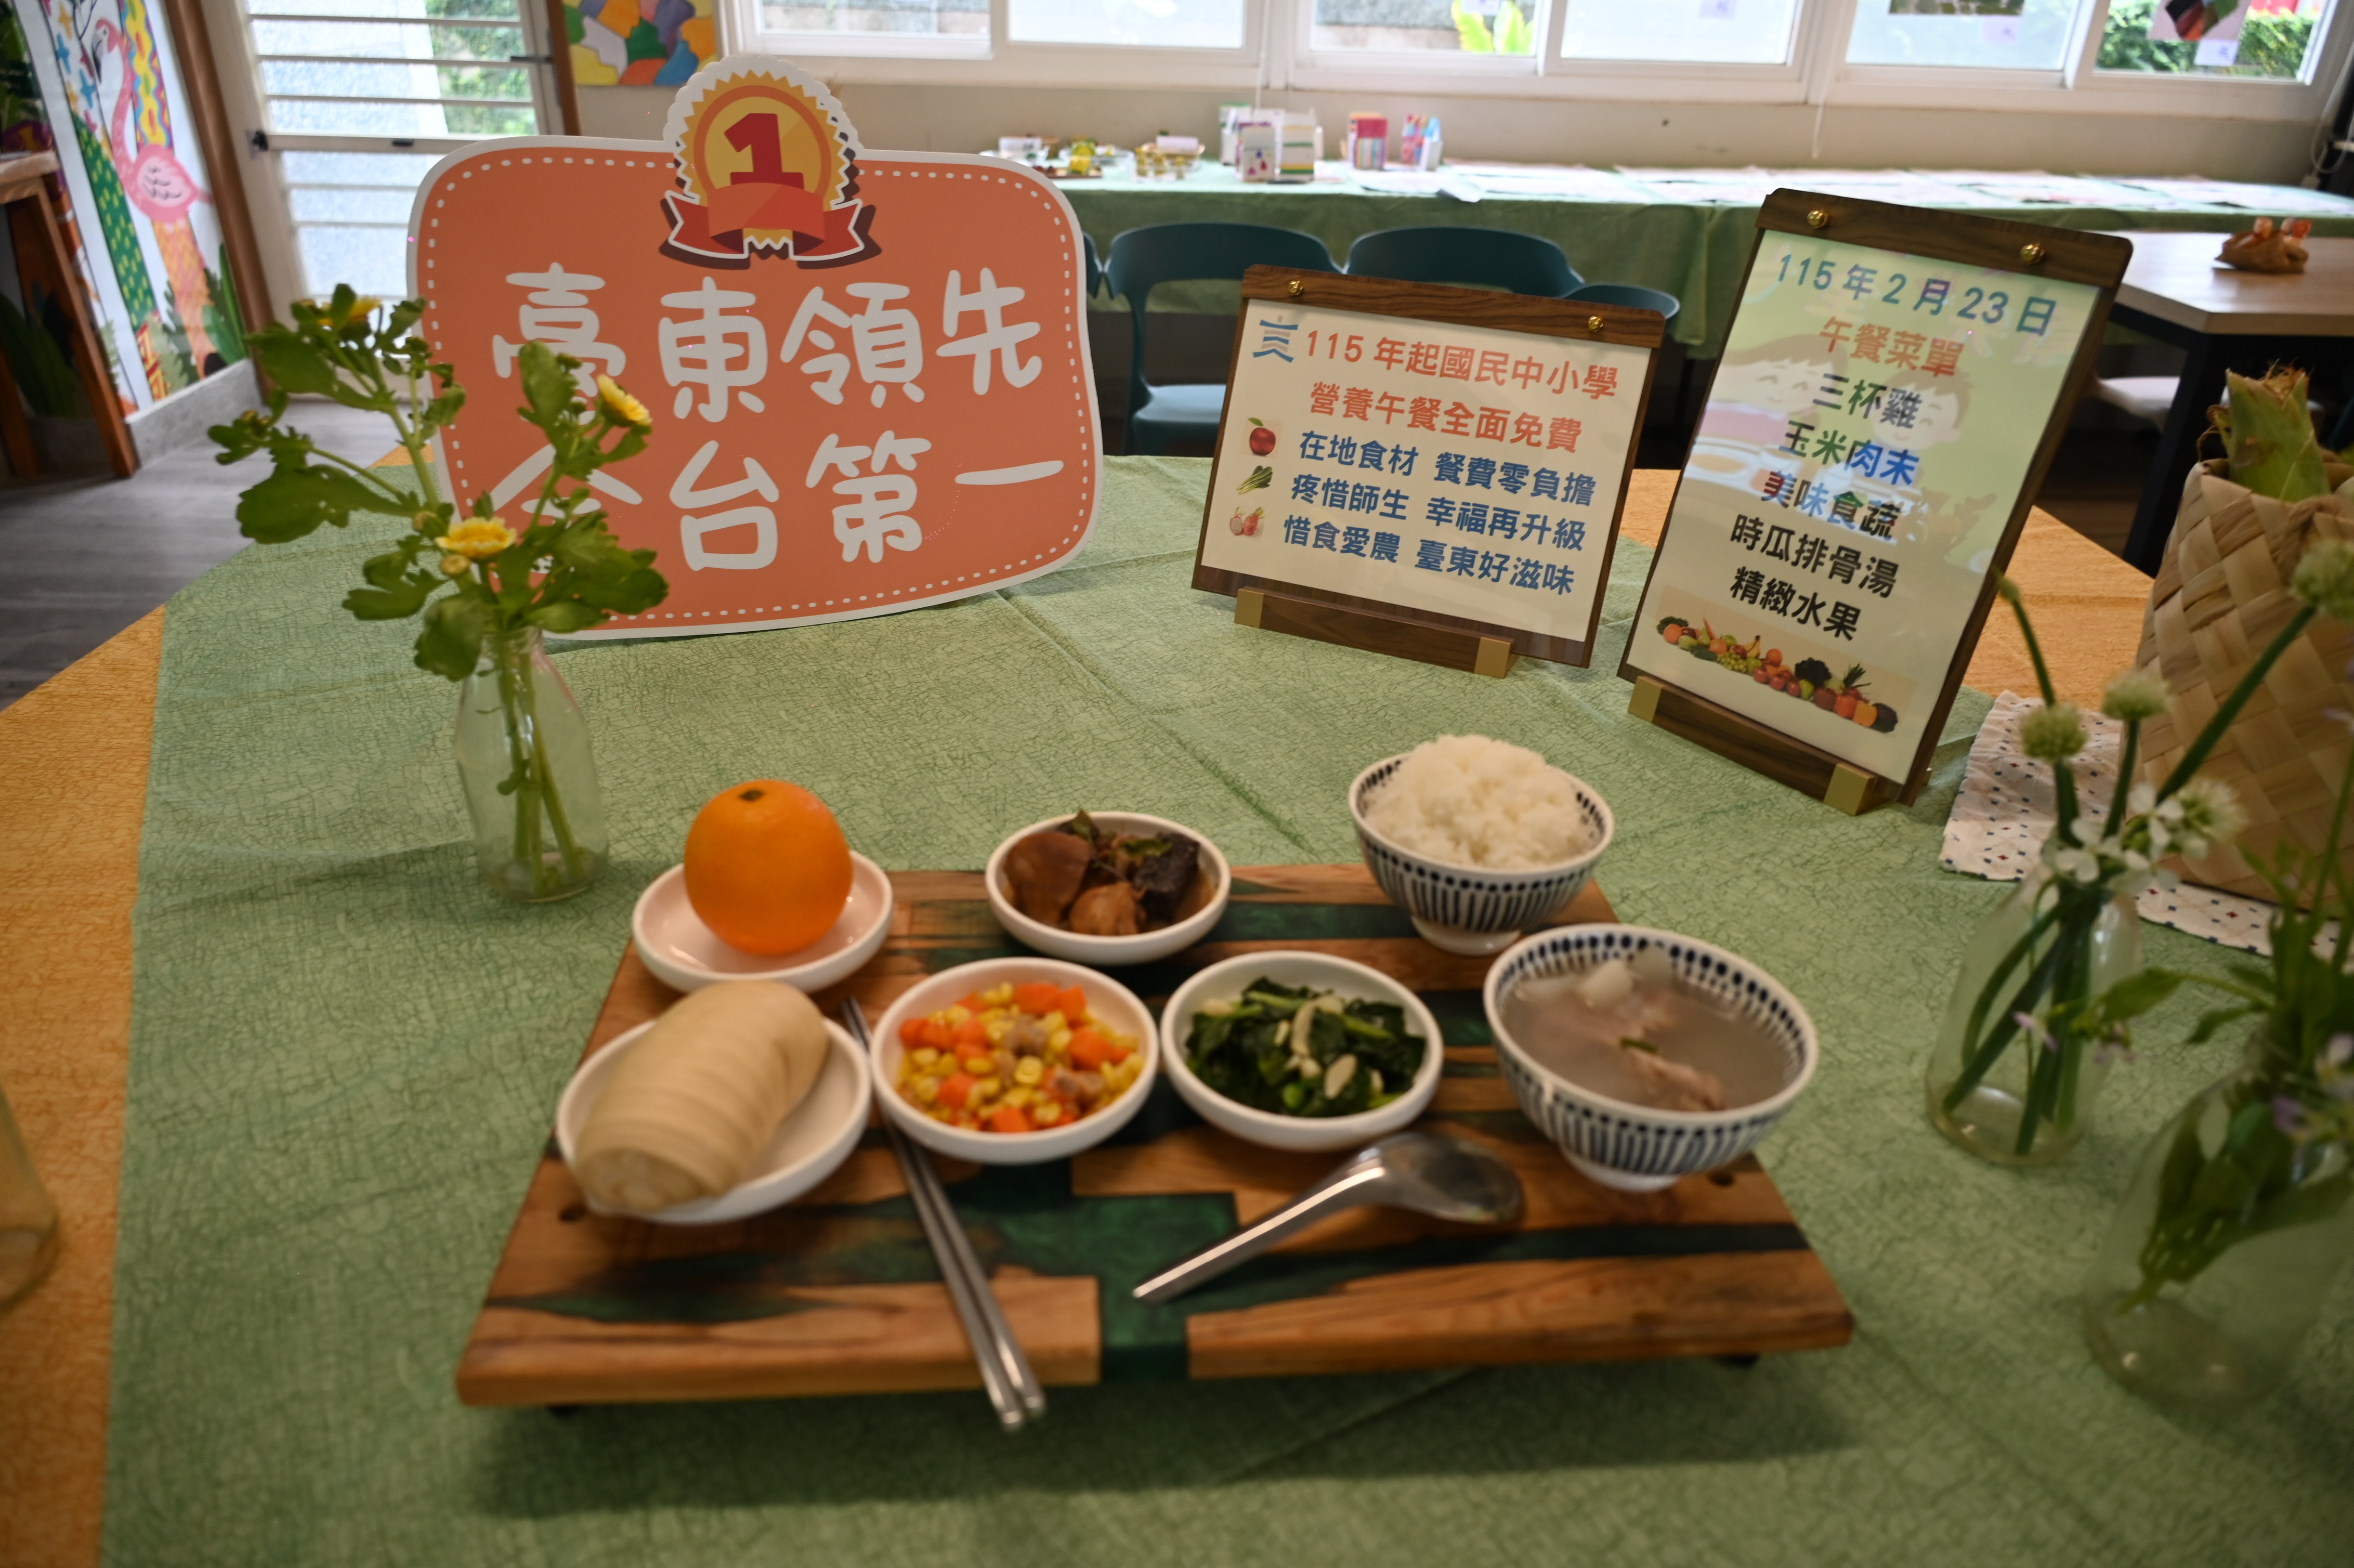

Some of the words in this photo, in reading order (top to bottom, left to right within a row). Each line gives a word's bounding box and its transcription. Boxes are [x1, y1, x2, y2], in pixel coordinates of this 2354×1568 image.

[724, 113, 804, 186] 1
[1819, 316, 1964, 377] 午餐菜單
[1311, 381, 1581, 453] 營養午餐全面免費
[1812, 373, 1923, 428] 三杯雞
[1300, 431, 1419, 476] 在地食材
[1434, 452, 1596, 506] 餐費零負擔
[1779, 420, 1919, 486] 玉米肉末
[1291, 474, 1409, 520] 疼惜師生
[1426, 498, 1585, 552] 幸福再升級
[1761, 470, 1901, 541] 美味食蔬
[1284, 515, 1401, 564] 惜食愛農
[1415, 539, 1574, 595] 臺東好滋味
[1730, 514, 1899, 598] 時瓜排骨湯
[1730, 566, 1861, 641] 精緻水果
